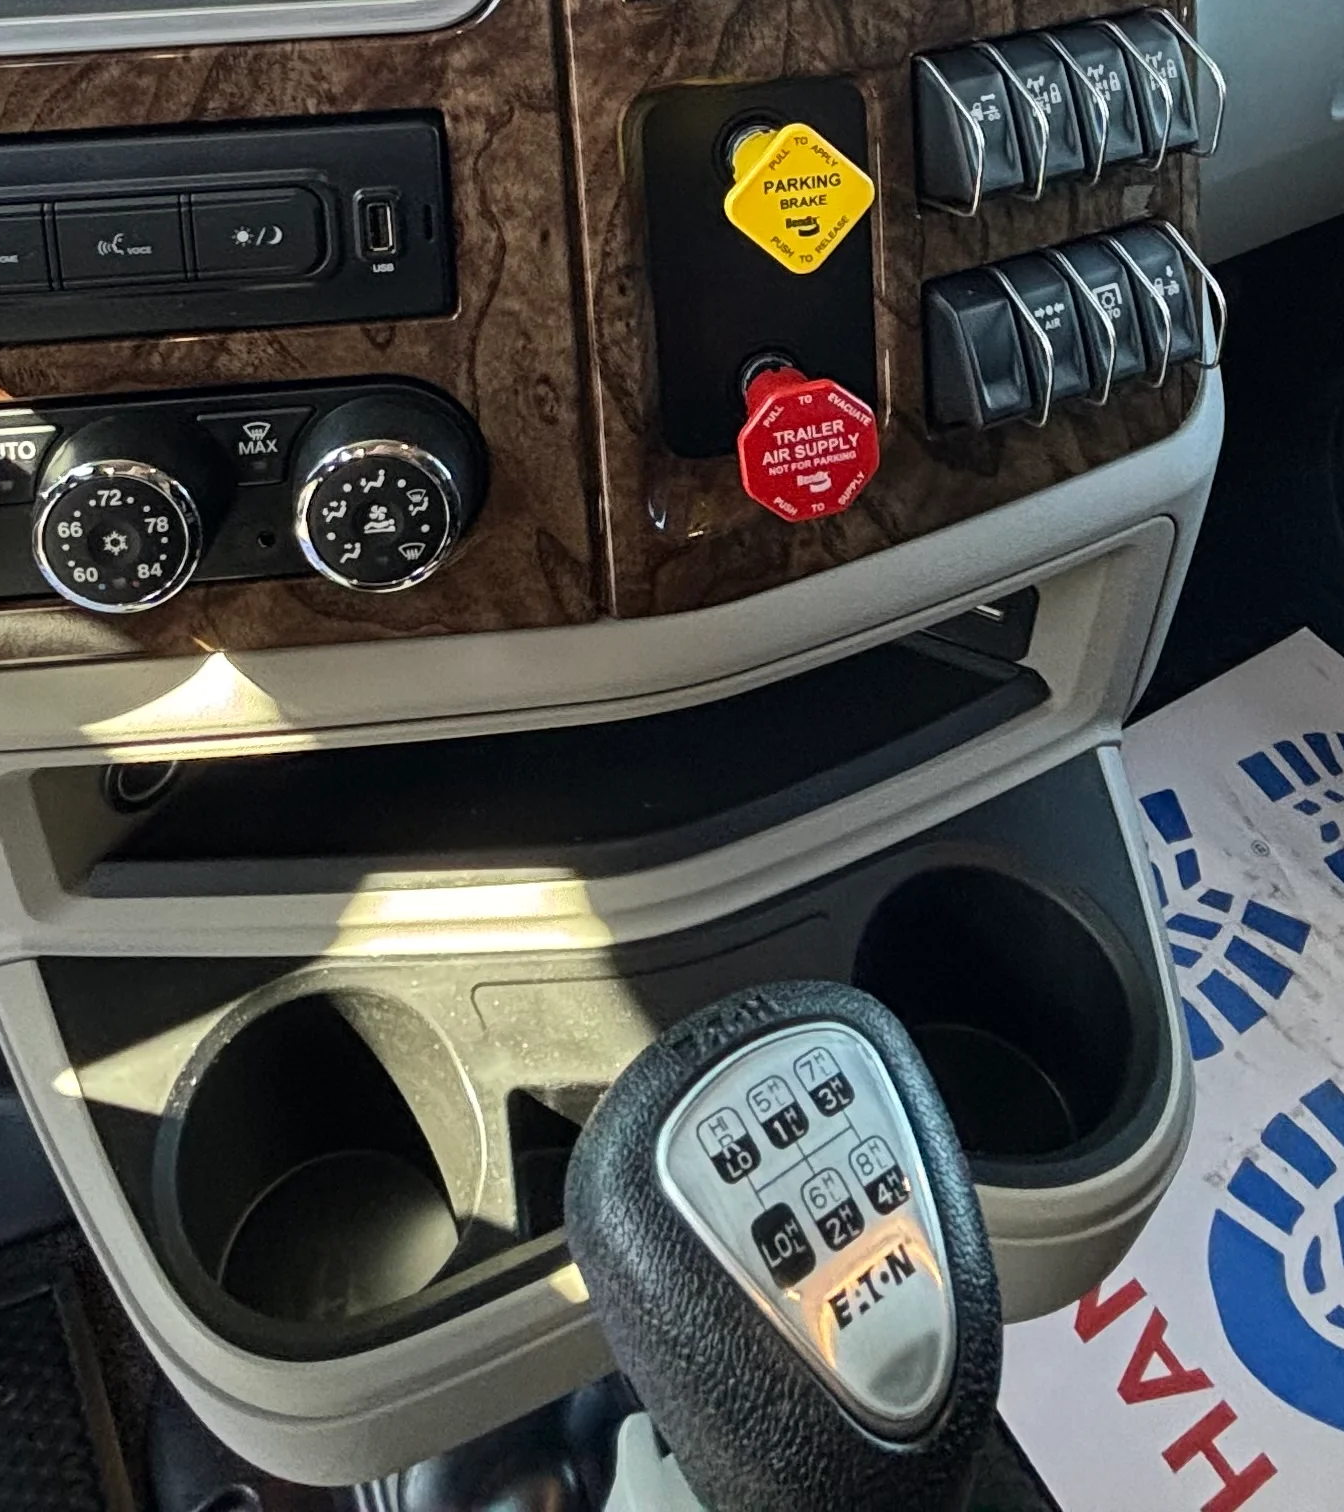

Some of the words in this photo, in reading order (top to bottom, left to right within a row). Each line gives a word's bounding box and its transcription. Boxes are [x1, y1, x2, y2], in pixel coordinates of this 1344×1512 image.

[768, 149, 791, 170] PULL
[794, 136, 808, 146] TO
[810, 144, 839, 167] APPLY
[763, 173, 841, 195] PARKING
[780, 194, 828, 210] BRAKE
[770, 236, 795, 258] PUSH
[799, 255, 814, 264] TO
[814, 215, 850, 254] RELEASE
[127, 243, 152, 256] VOICE
[372, 262, 395, 273] USB
[1045, 317, 1061, 330] AIR
[762, 405, 785, 428] PULL
[798, 394, 813, 405] TO
[827, 392, 873, 427] EVACUATE
[773, 419, 845, 447] TRAILER
[238, 437, 278, 456] MAX
[762, 447, 791, 466] AIR
[794, 432, 860, 459] SUPPLY
[768, 464, 789, 477] NOT
[791, 460, 812, 472] FOR
[813, 450, 857, 466] PARKING
[97, 489, 123, 508] 72
[773, 496, 798, 517] PUSH
[811, 502, 825, 513] TO
[837, 470, 866, 506] SUPPLY
[56, 519, 84, 540] 66
[144, 516, 170, 535] 78
[72, 567, 99, 584] 60
[136, 562, 163, 580] 84
[813, 1051, 826, 1065] H
[799, 1060, 816, 1083] 7
[819, 1066, 832, 1077] L
[767, 1080, 780, 1092] H
[830, 1077, 843, 1090] H
[752, 1090, 772, 1113] 5
[775, 1096, 786, 1107] L
[818, 1088, 837, 1111] 3
[836, 1092, 850, 1105] L
[784, 1107, 797, 1124] H
[708, 1115, 729, 1137] HI
[773, 1120, 789, 1142] 1
[791, 1125, 805, 1137] L
[718, 1134, 741, 1160] R
[867, 1140, 882, 1154] H
[726, 1151, 753, 1178] LO
[856, 1152, 875, 1177] 8
[875, 1157, 888, 1169] L
[821, 1172, 835, 1185] H
[886, 1170, 900, 1186] H
[808, 1186, 827, 1210] 6
[829, 1190, 841, 1203] L
[877, 1182, 894, 1206] 4
[894, 1190, 907, 1202] L
[838, 1204, 853, 1220] H
[784, 1218, 799, 1234] H
[825, 1217, 846, 1246] 2
[846, 1223, 861, 1236] L
[761, 1232, 792, 1268] LO
[793, 1240, 806, 1254] L
